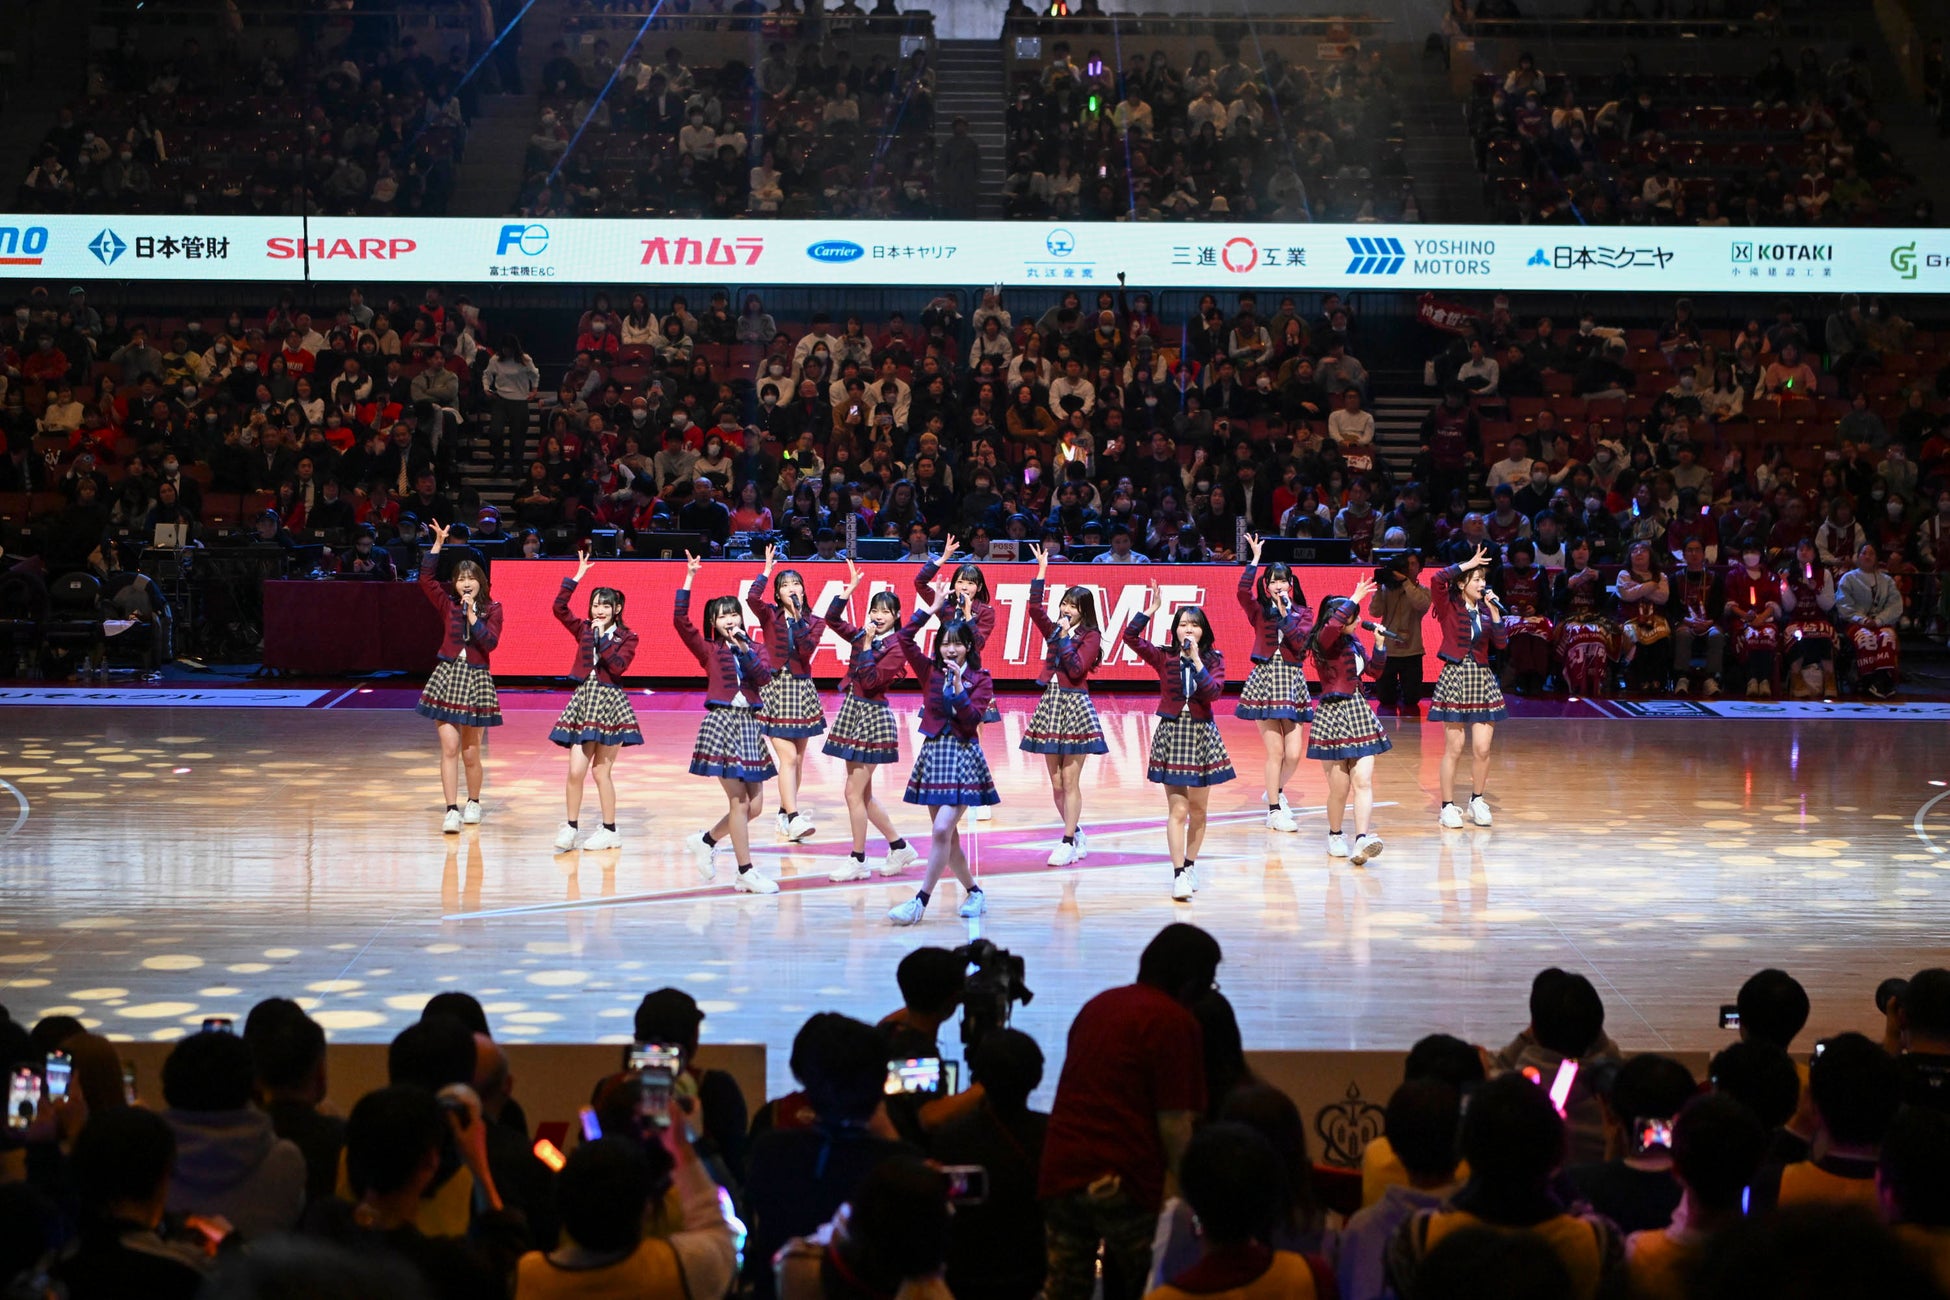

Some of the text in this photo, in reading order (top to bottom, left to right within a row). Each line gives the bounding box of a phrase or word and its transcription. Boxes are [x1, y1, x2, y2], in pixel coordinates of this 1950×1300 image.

[136, 236, 230, 260] 日本管財
[266, 237, 417, 260] SHARP
[641, 237, 764, 265] オカムラ
[814, 245, 858, 257] Carrier
[873, 245, 957, 259] 日本キャリア
[1415, 240, 1495, 255] YOSHINO
[1758, 244, 1832, 261] KOTAKI
[1171, 246, 1307, 267] 三進 工業
[1554, 245, 1674, 270] 日本ミクニヤ
[489, 265, 554, 277] 富士電機E&C
[1414, 259, 1490, 275] MOTORS
[993, 542, 1014, 550] POSS
